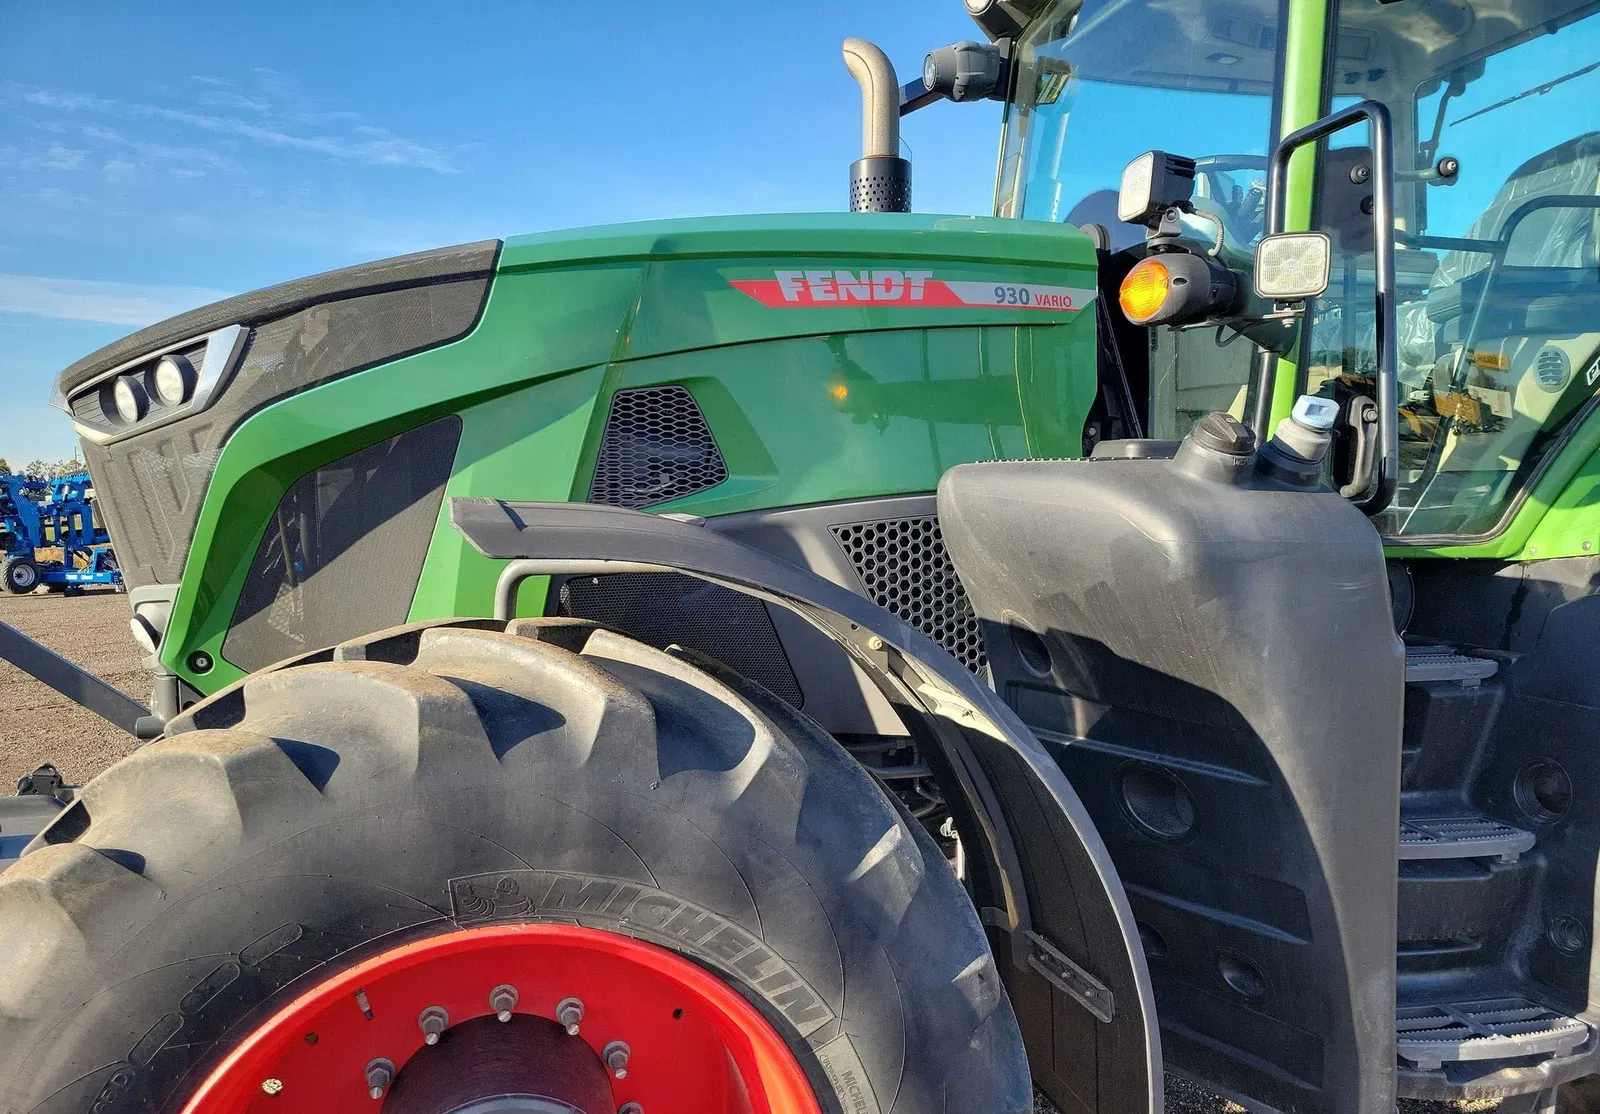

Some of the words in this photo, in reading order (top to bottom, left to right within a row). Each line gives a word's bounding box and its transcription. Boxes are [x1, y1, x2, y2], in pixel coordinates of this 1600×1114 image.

[774, 270, 933, 302] FENDT
[994, 286, 1030, 305] 930
[1034, 293, 1072, 307] VARIO
[540, 876, 829, 1024] MICHELIN
